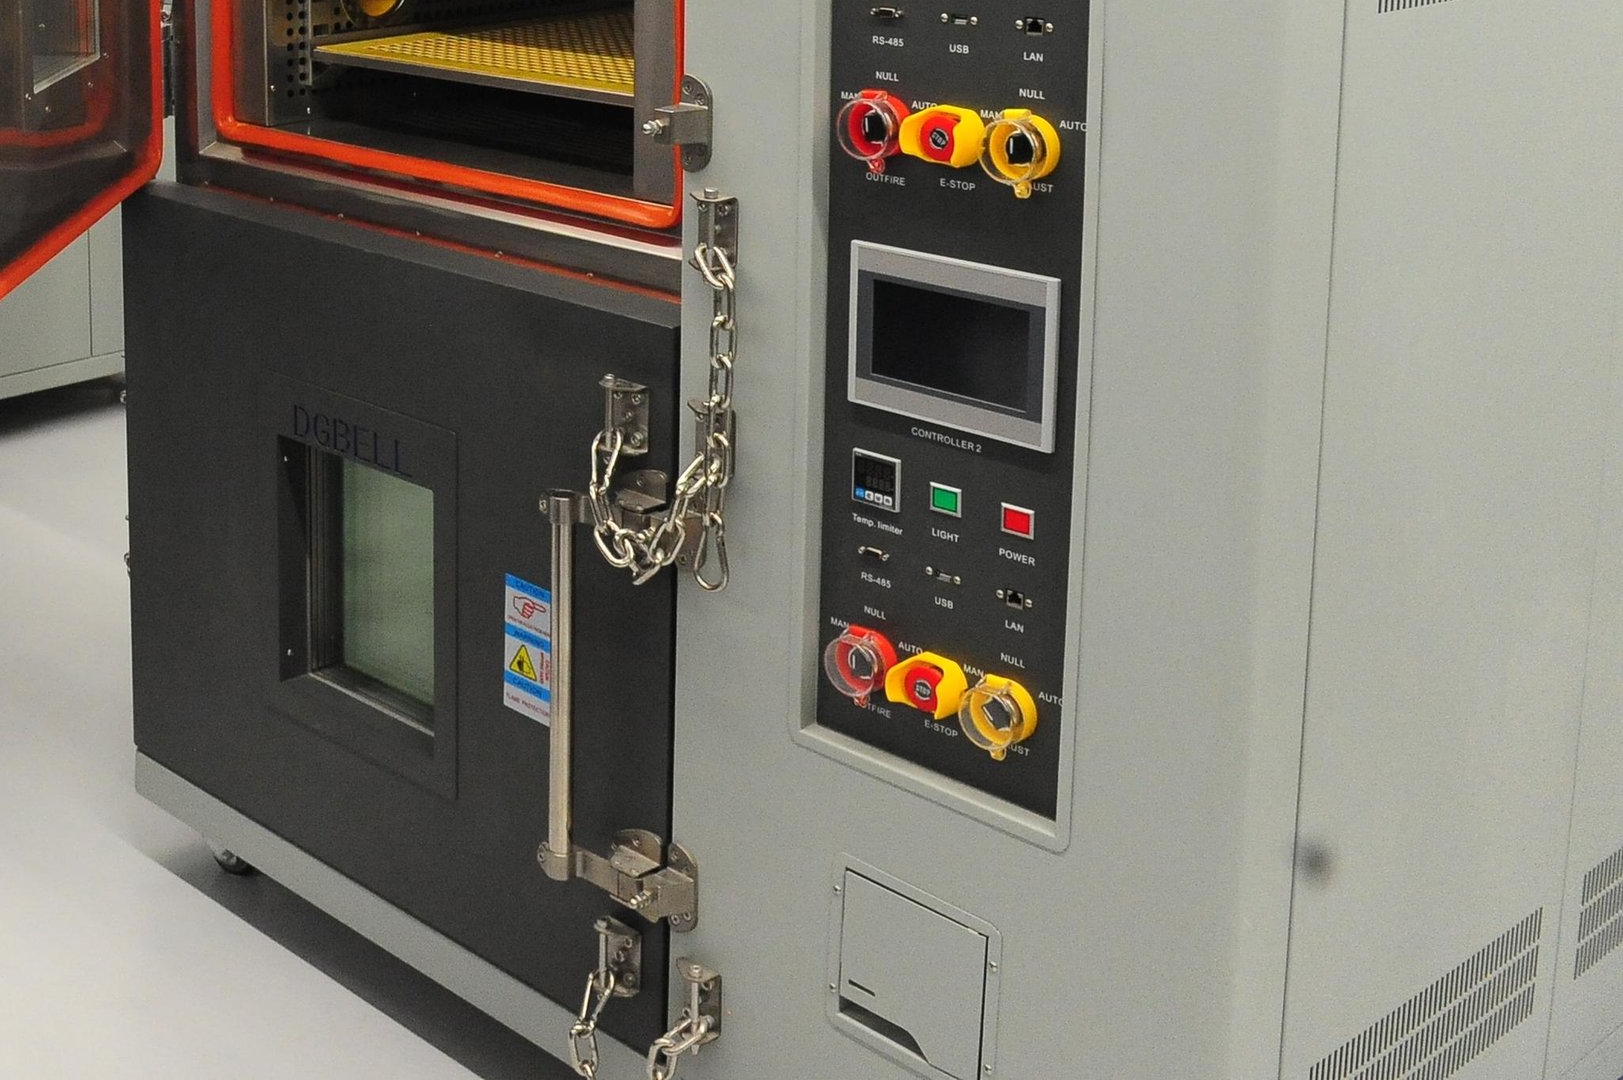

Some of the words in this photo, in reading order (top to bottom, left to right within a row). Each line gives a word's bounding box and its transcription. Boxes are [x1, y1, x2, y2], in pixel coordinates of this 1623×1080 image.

[872, 36, 904, 47] RS-485
[949, 44, 970, 54] USB
[1023, 52, 1044, 62] LAN
[876, 71, 899, 82] NULL
[1019, 88, 1046, 100] NULL
[866, 172, 906, 186] OUTFIRE
[940, 178, 976, 192] E-STOP
[294, 404, 413, 478] DGBELL
[911, 426, 974, 452] CONTROLLER
[976, 444, 982, 453] 2
[852, 512, 876, 528] Temp.
[877, 520, 903, 536] limiter
[931, 527, 960, 542] LIGHT
[998, 548, 1036, 566] POWER
[860, 571, 892, 589] RS-485
[934, 596, 954, 610] USB
[864, 606, 886, 620] NULL
[830, 617, 849, 628] MAN
[1004, 620, 1024, 633] LAN
[898, 640, 922, 655] AUTO
[1000, 652, 1026, 669] NULL
[964, 664, 985, 678] MAN
[924, 720, 959, 737] E-STOP
